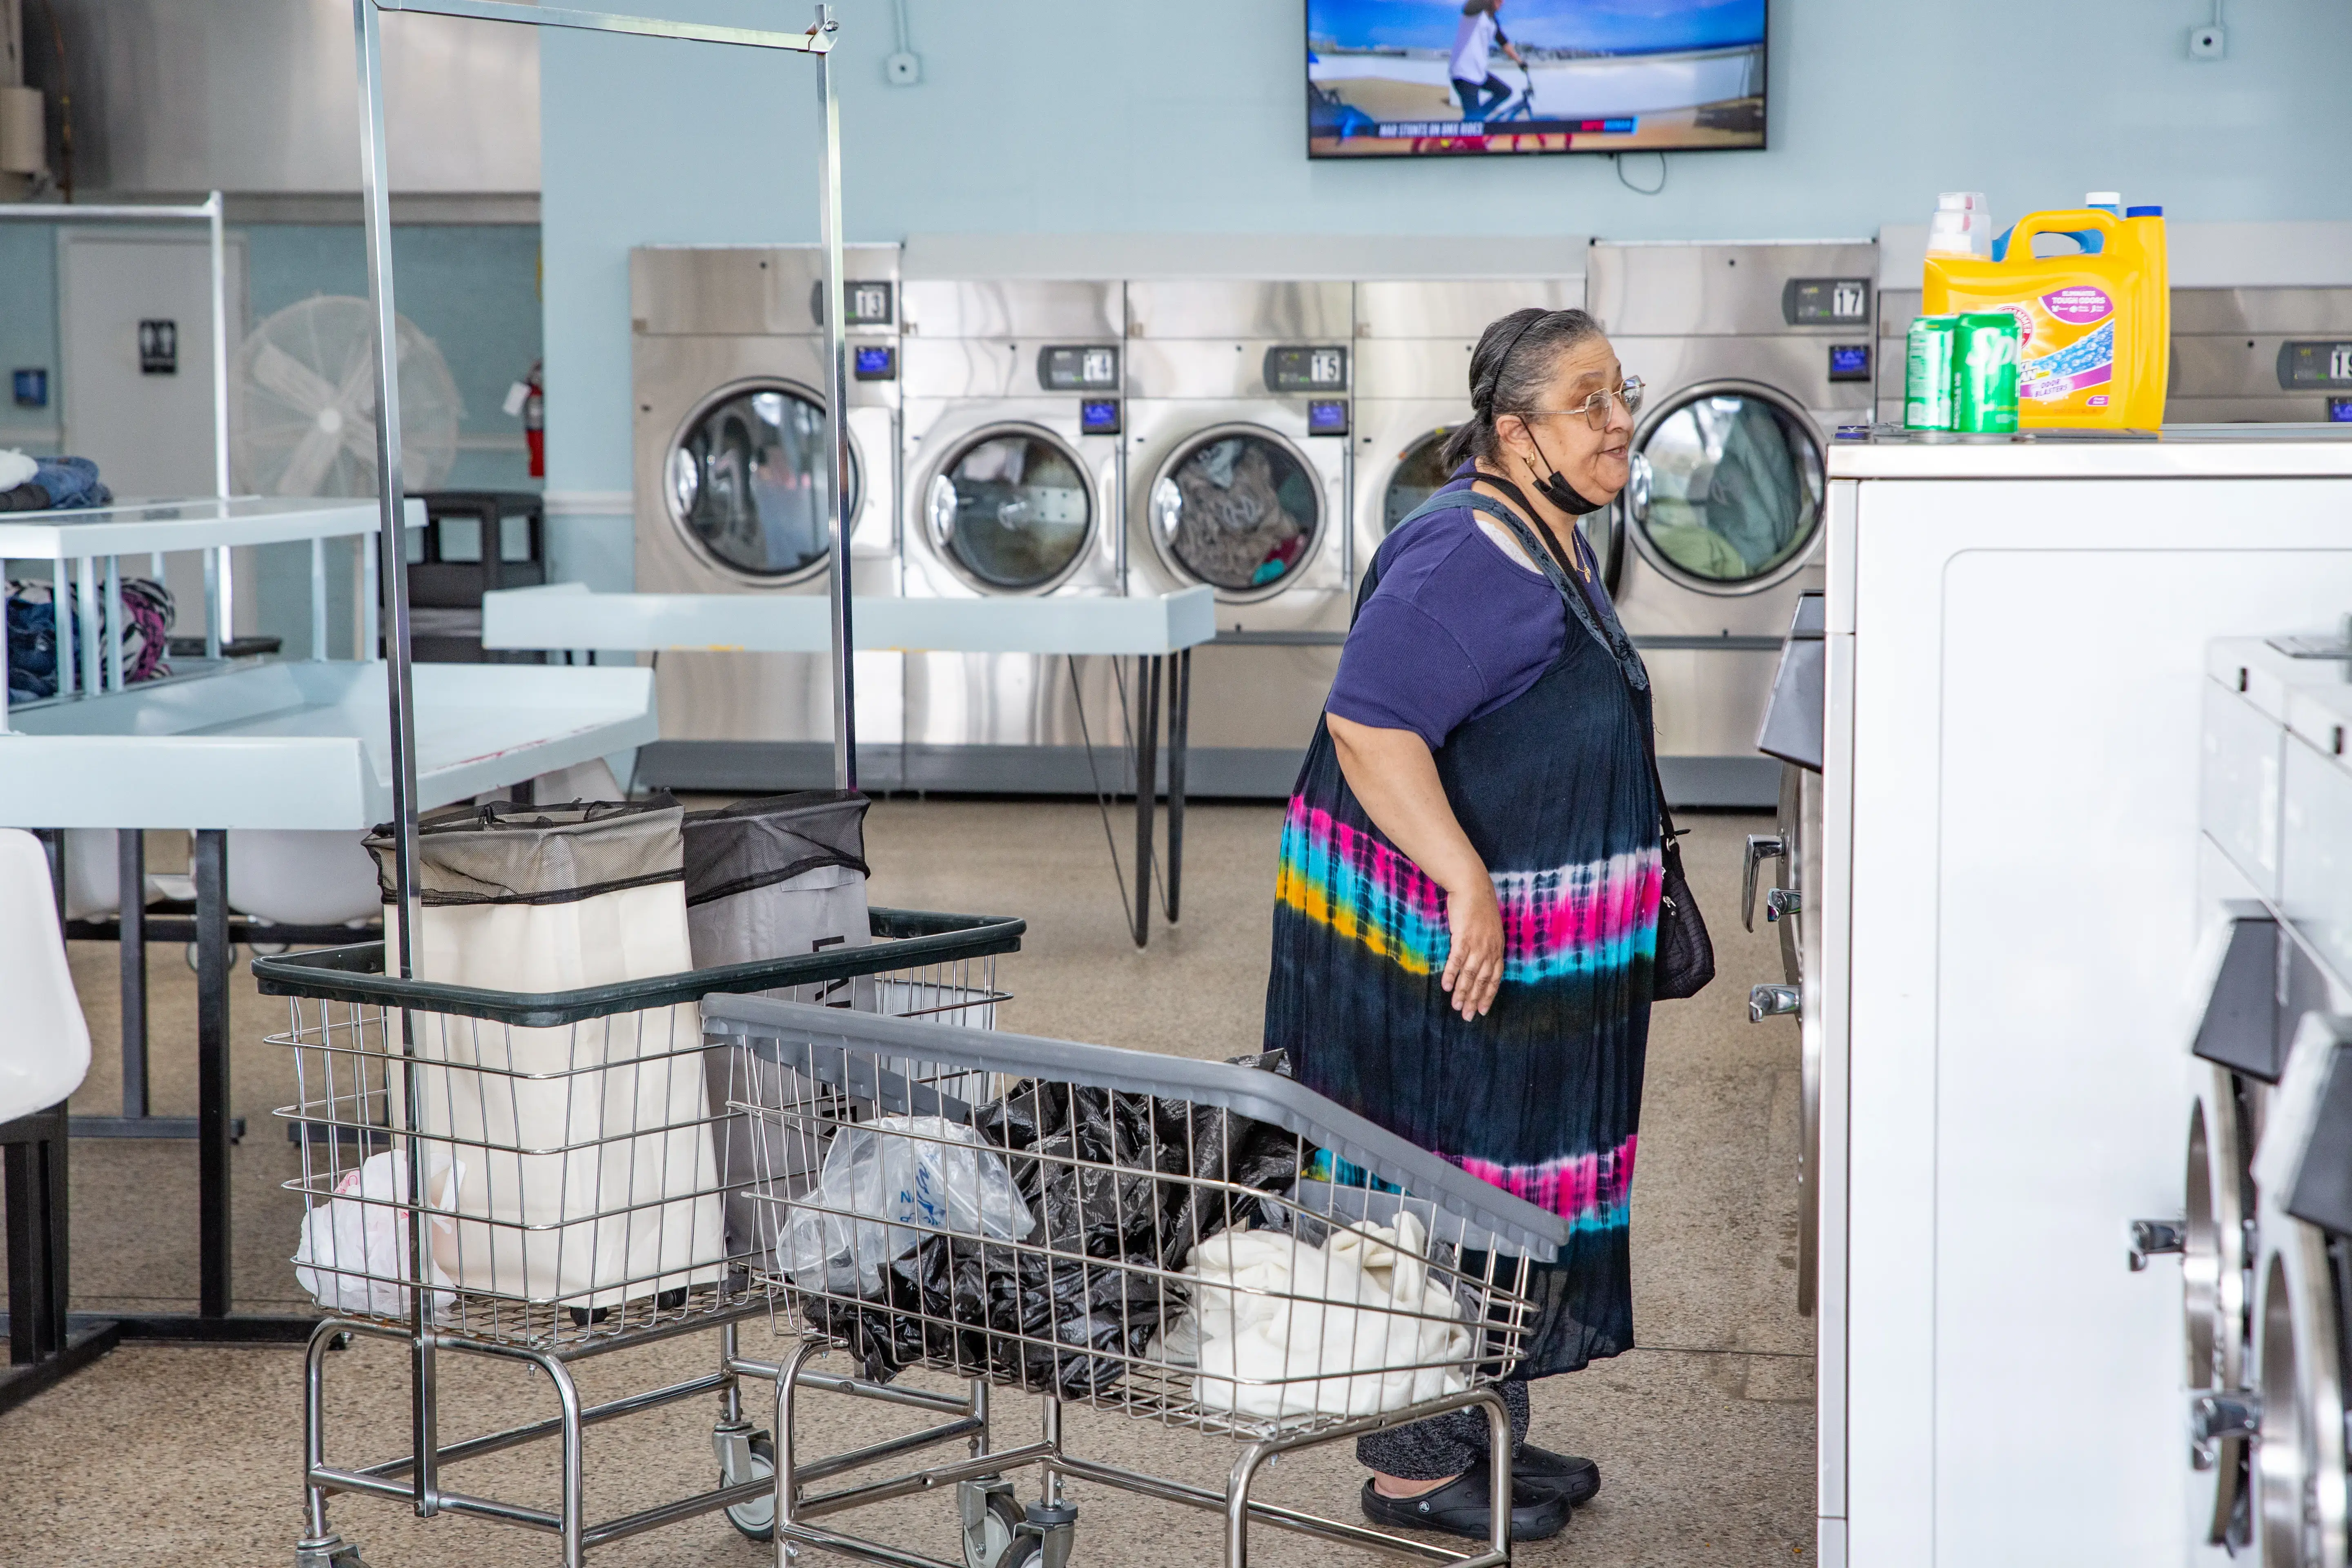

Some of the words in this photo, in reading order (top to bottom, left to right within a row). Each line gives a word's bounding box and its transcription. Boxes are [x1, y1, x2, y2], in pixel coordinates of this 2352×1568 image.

[861, 294, 881, 315] 13
[1838, 288, 1860, 313] 17
[1314, 357, 1337, 379] 15
[2035, 384, 2068, 397] BLASTERS
